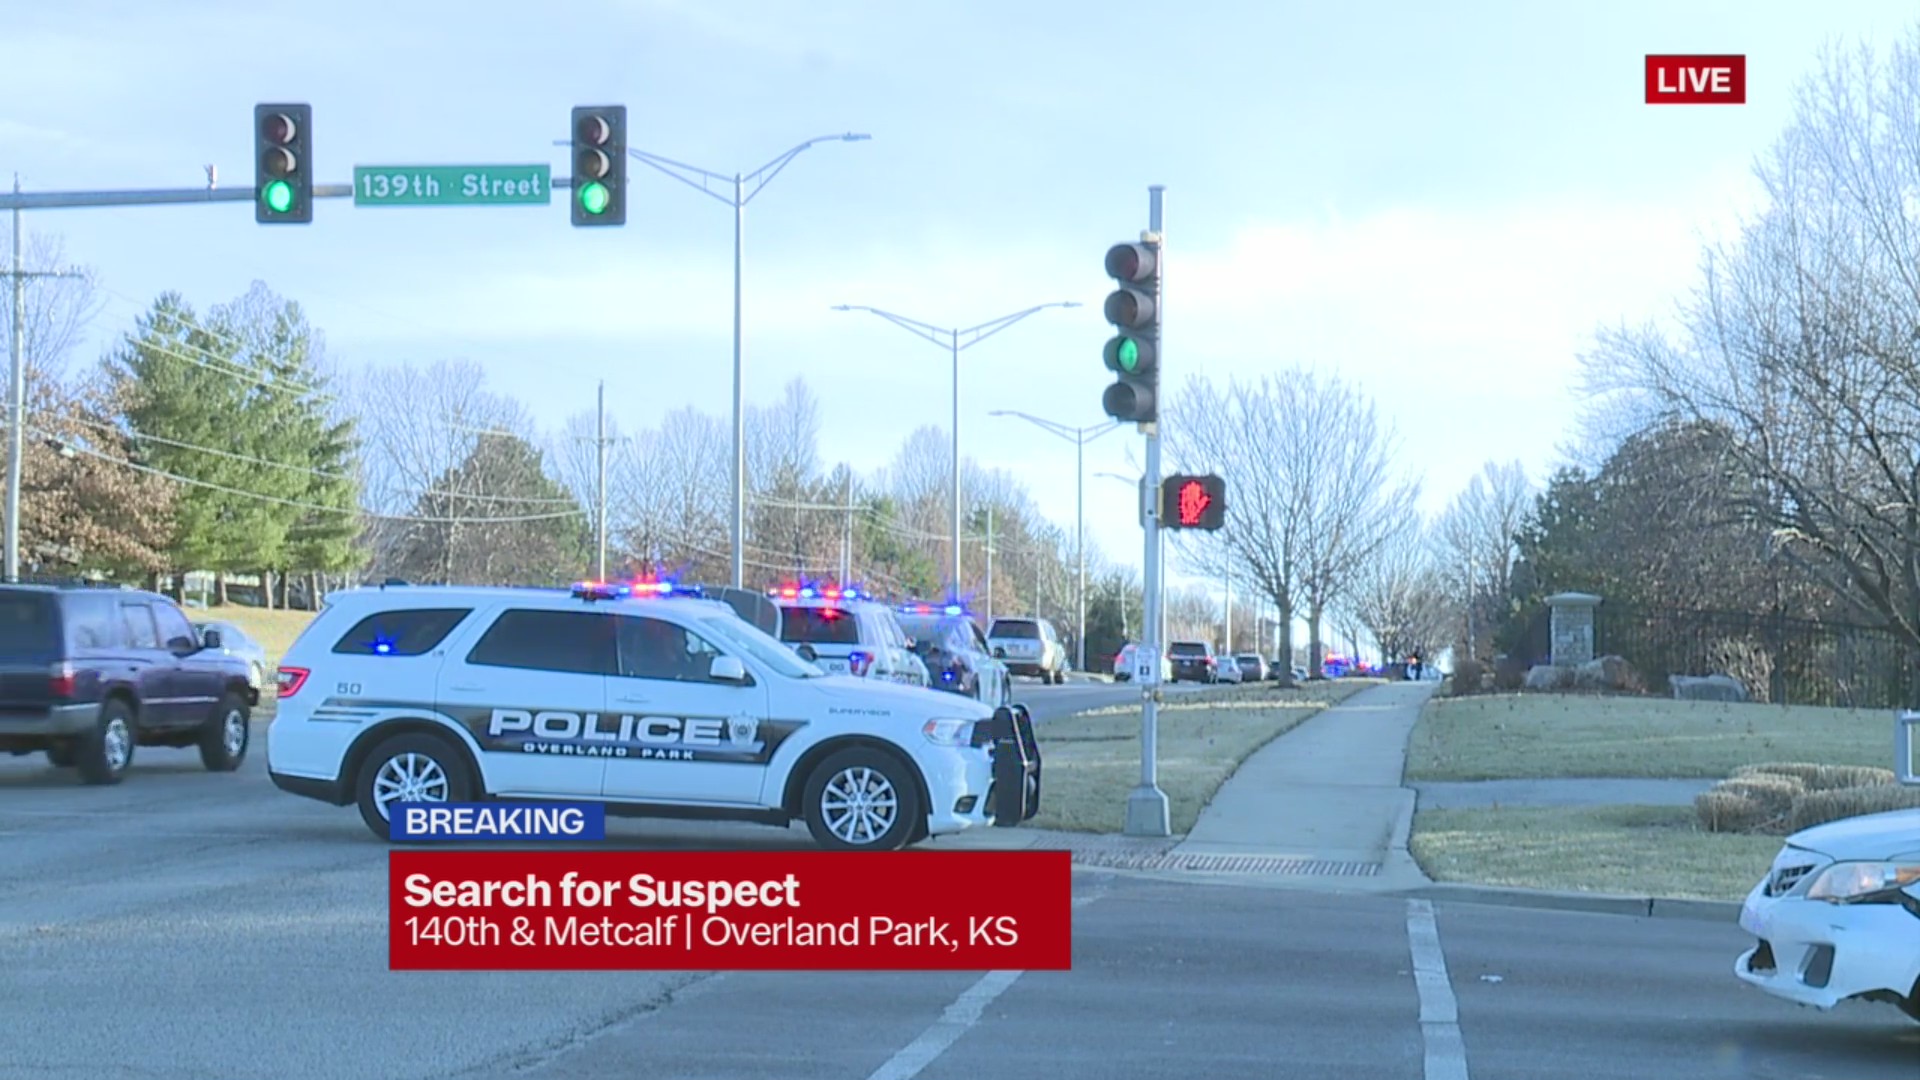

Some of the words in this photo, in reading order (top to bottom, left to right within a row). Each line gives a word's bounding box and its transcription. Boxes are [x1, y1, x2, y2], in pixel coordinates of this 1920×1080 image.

[363, 173, 440, 198] 139th
[462, 172, 541, 197] Street
[488, 708, 724, 747] POLICE
[523, 742, 628, 758] OVERLAND
[641, 748, 695, 761] PARK
